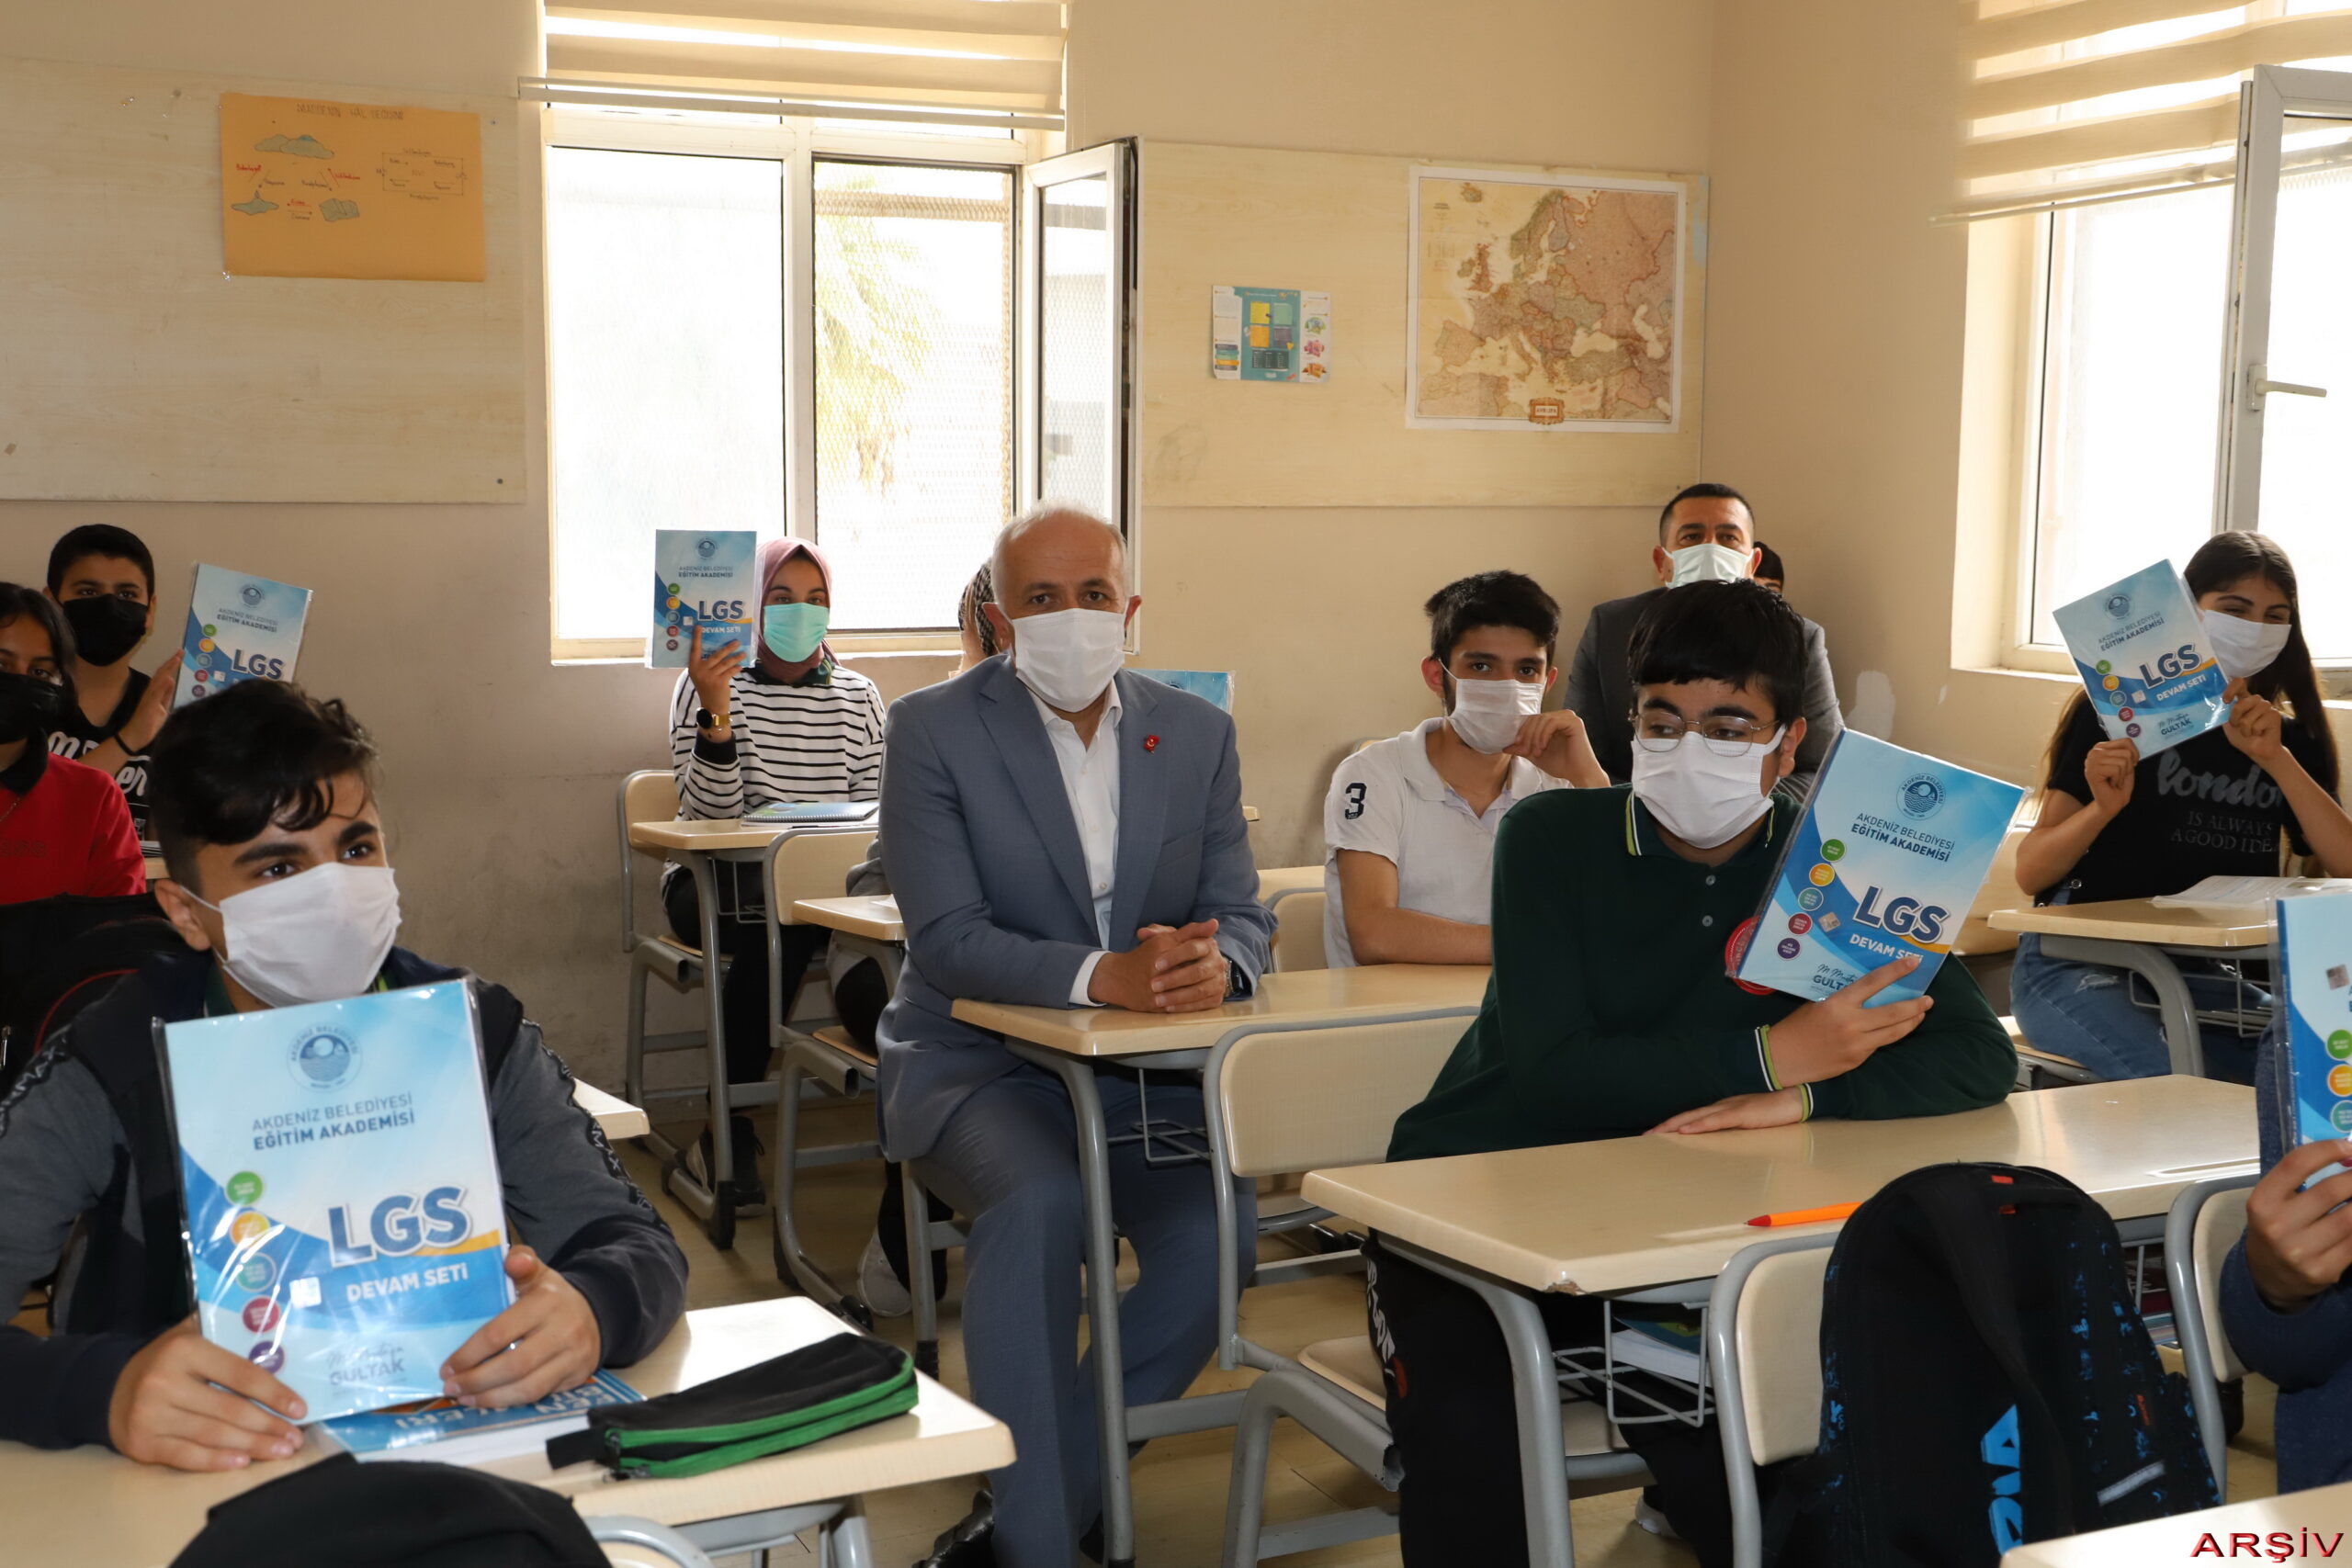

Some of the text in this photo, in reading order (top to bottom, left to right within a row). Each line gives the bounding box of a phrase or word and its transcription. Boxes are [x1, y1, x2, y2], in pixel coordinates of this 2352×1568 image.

[698, 599, 744, 620] LGS
[232, 648, 285, 681] LGS
[2139, 643, 2200, 689] LGS
[2155, 683, 2187, 702] DEVAM
[1345, 783, 1367, 819] 3
[2188, 810, 2203, 826] IS
[1851, 822, 1951, 863] EĞİTİM AKADEMİSİ
[1856, 812, 1900, 833] AKDENİZ
[1900, 827, 1956, 852] BELEDİYESİ
[2185, 829, 2236, 850] GOOD
[2241, 838, 2278, 853] IDE
[1854, 886, 1949, 942] LGS
[1849, 933, 1895, 957] DEVAM
[252, 1090, 413, 1133] AKDENİZ BELEDİYESİ
[253, 1107, 415, 1151] EĞİTİM AKADEMİSİ
[327, 1185, 470, 1268] LGS
[345, 1262, 469, 1303] DEVAM SETİ
